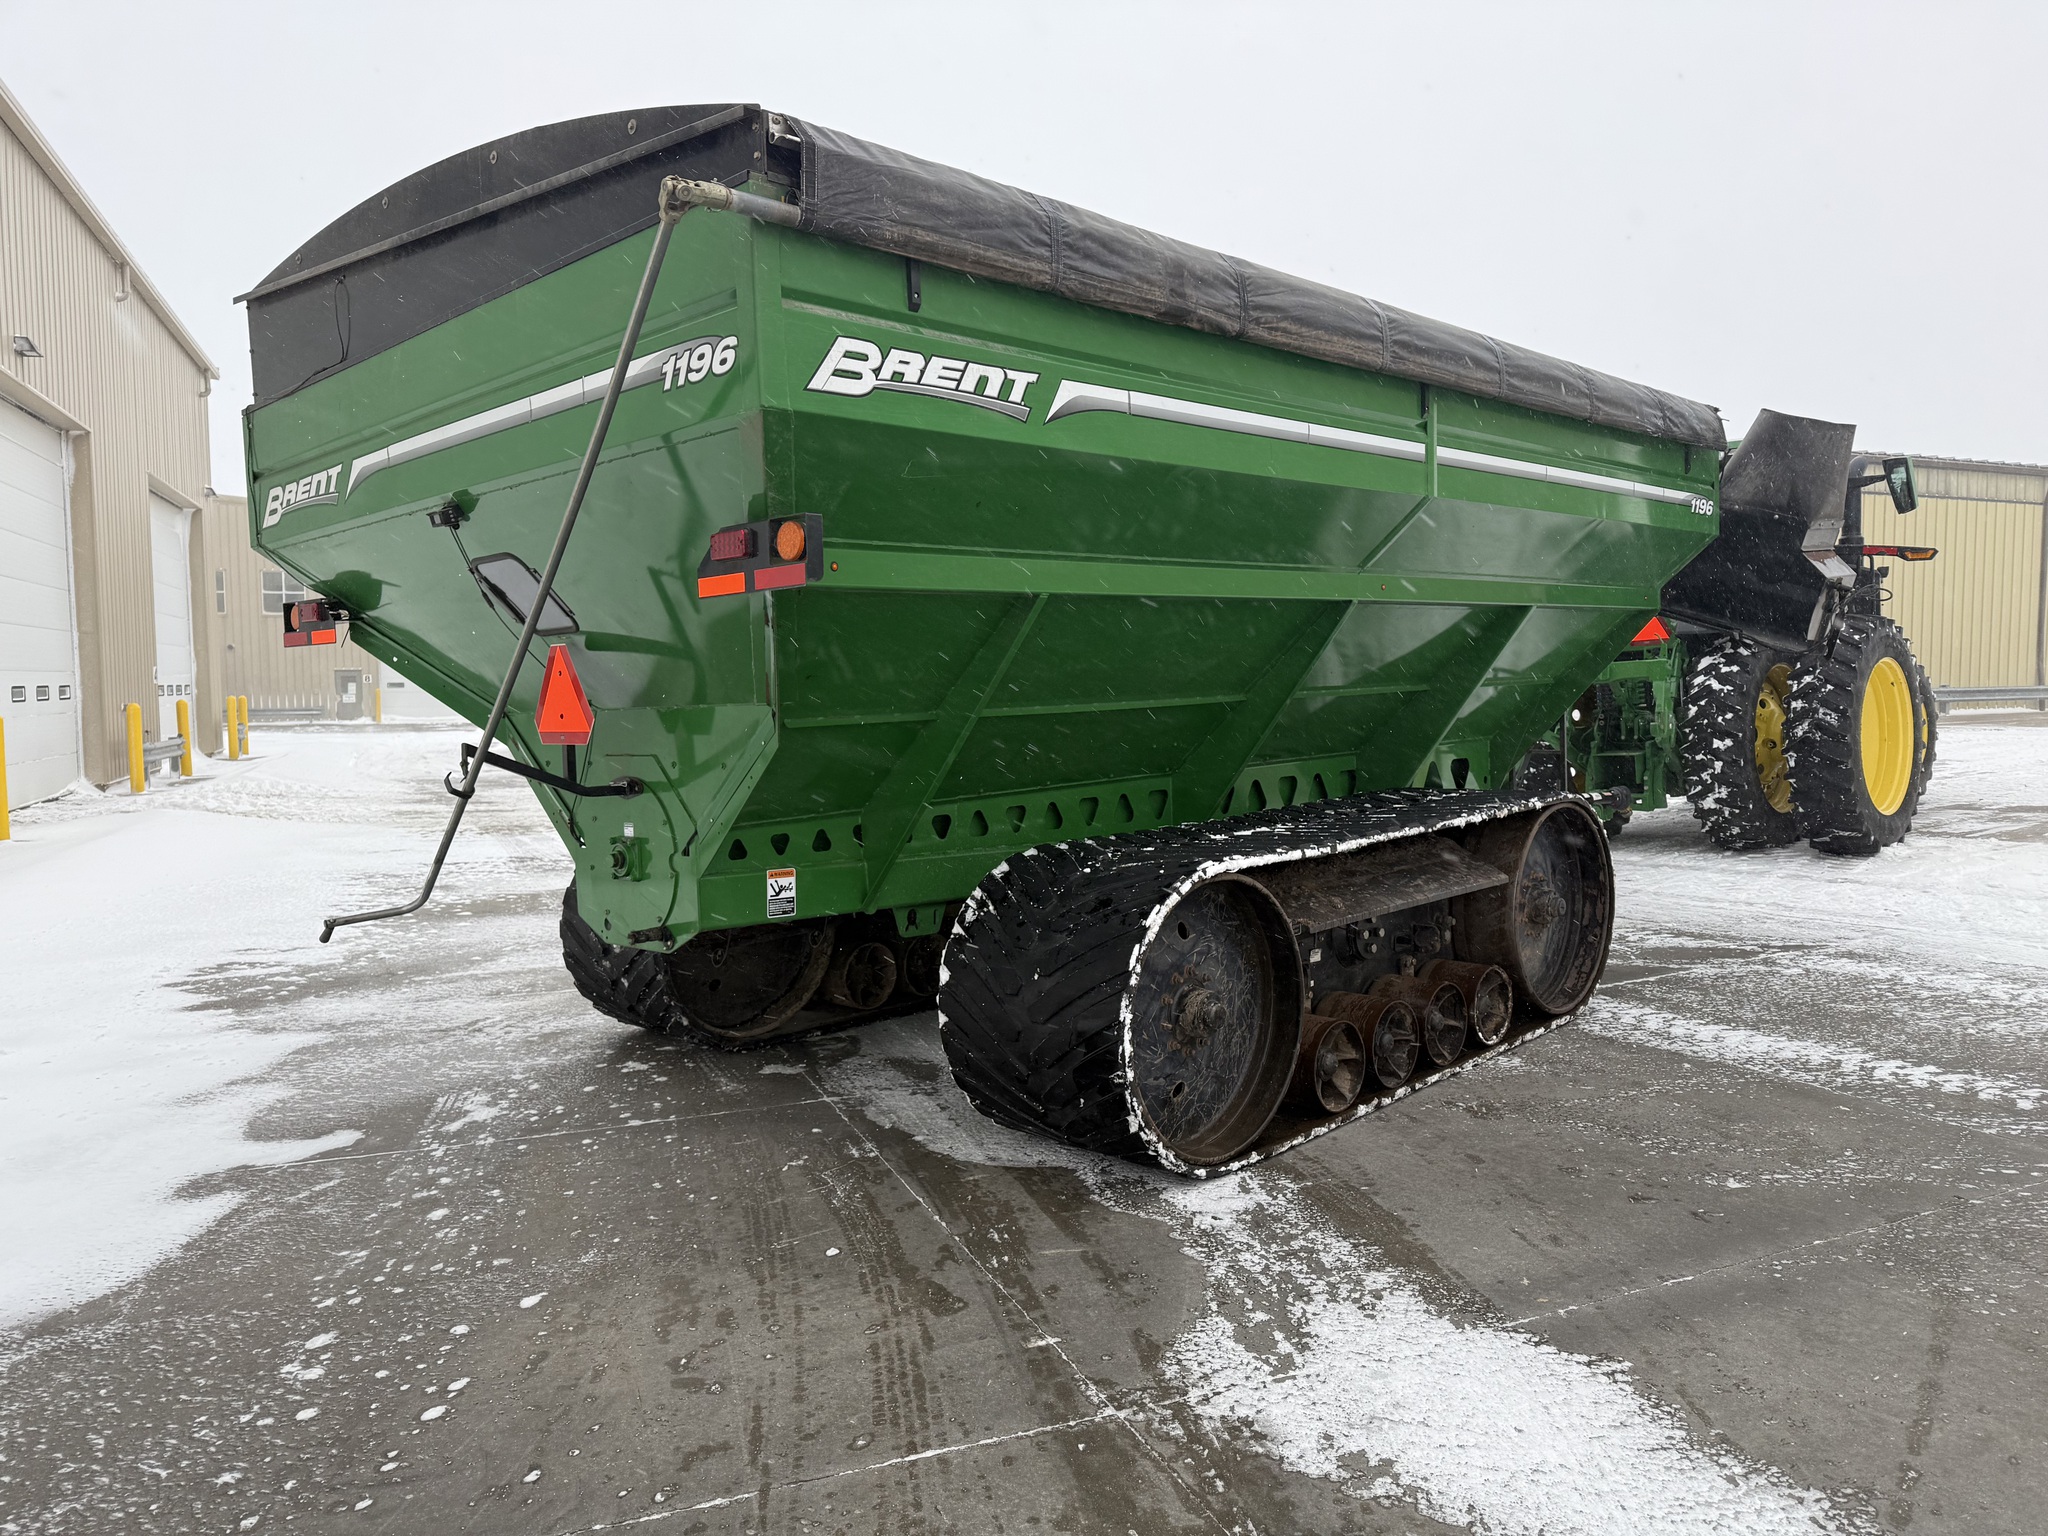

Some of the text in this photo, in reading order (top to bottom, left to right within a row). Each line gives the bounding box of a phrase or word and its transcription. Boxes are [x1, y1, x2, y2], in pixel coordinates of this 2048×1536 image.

[661, 335, 738, 391] 1196
[805, 335, 1041, 406] BRENT
[262, 463, 343, 529] BRENT
[1691, 497, 1714, 516] 1196
